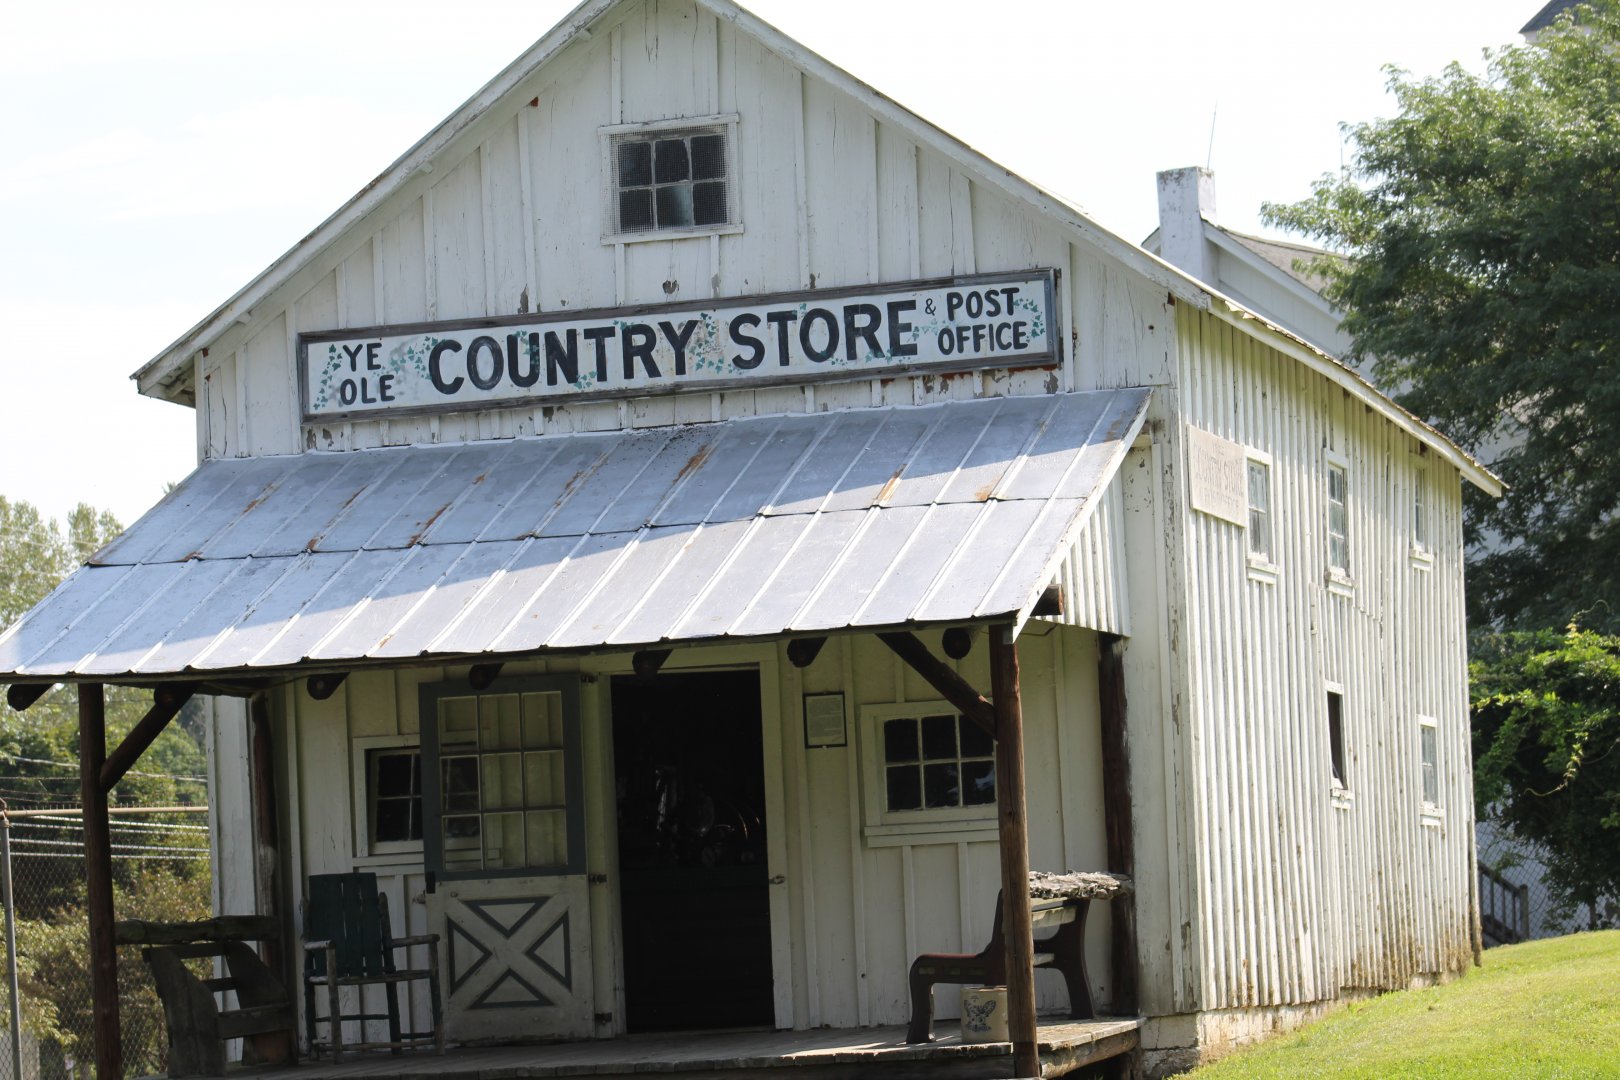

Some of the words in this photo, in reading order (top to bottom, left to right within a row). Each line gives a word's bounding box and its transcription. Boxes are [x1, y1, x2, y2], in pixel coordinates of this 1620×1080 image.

[924, 297, 937, 316] &
[946, 286, 1020, 321] POST
[428, 319, 699, 395] COUNTRY
[728, 300, 918, 370] STORE
[937, 320, 1029, 356] OFFICE
[342, 342, 382, 372] YE
[340, 374, 396, 406] OLE
